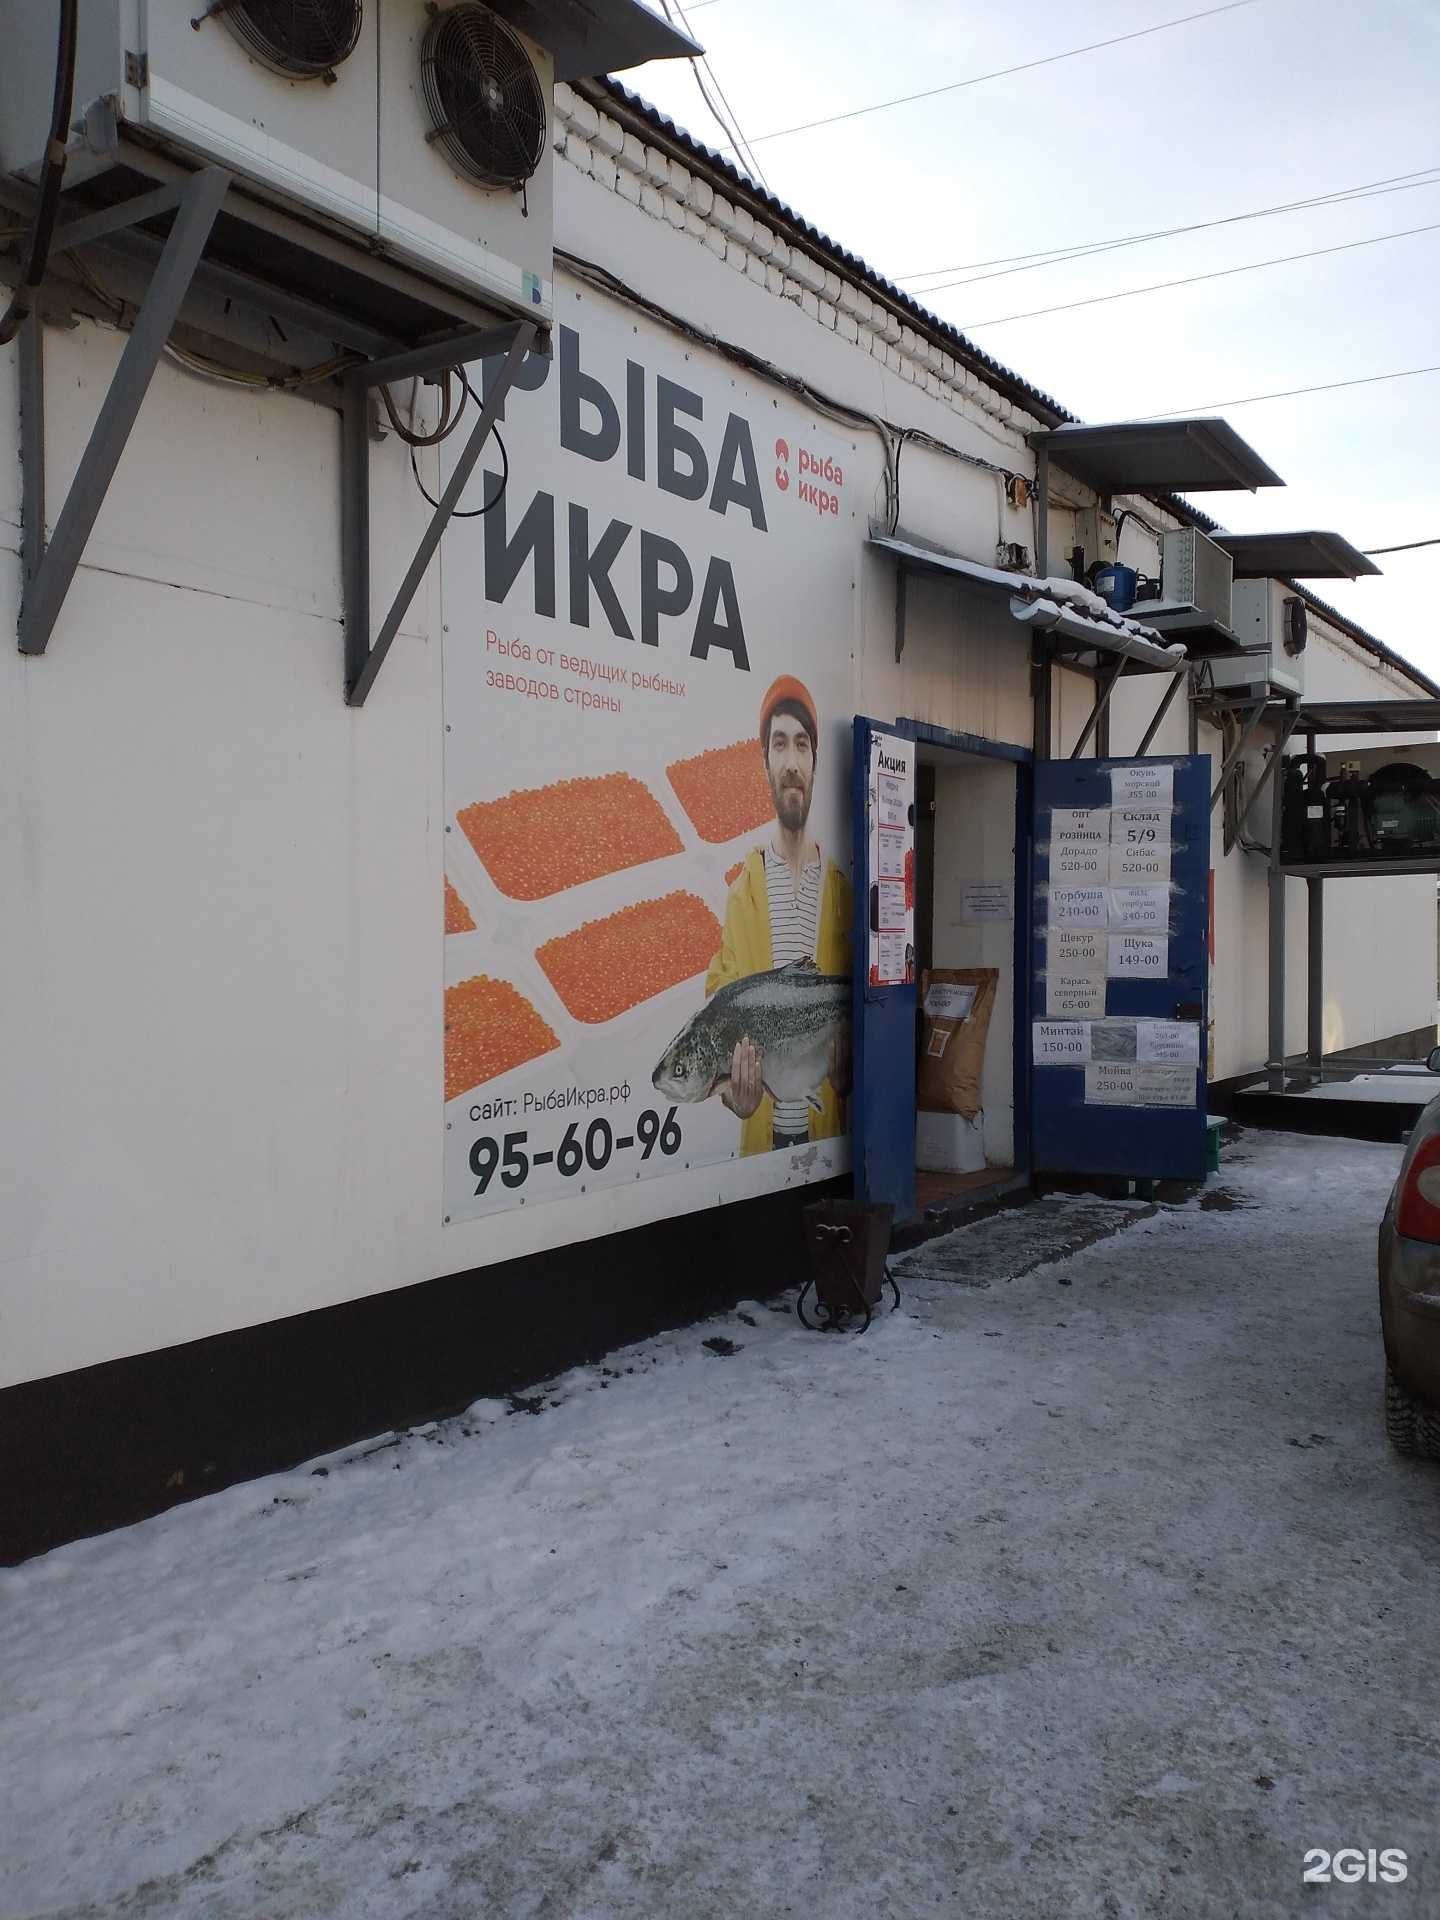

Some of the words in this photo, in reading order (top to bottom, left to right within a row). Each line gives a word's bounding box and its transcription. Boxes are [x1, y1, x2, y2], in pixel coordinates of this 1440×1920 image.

[798, 446, 843, 488] рыба
[798, 480, 839, 516] икра
[483, 469, 751, 672] ИКРА
[486, 628, 531, 663] Рыба
[536, 648, 555, 667] от
[560, 653, 628, 685] ведущих
[632, 669, 686, 698] рыбных
[486, 669, 560, 701] заводов
[563, 688, 621, 713] страны
[877, 749, 906, 775] Акция
[1123, 812, 1161, 823] Склад
[1058, 832, 1102, 840] РОЗНИЦА
[1126, 828, 1156, 845] 5/9
[1060, 846, 1098, 857] Дорадо
[1126, 847, 1156, 857] Сибас
[1061, 861, 1097, 871] 520-00
[1122, 863, 1159, 873] 520-00
[1054, 890, 1104, 901] Горбуша
[1058, 907, 1099, 917] 240-00
[1060, 933, 1094, 945] Щекур
[1123, 938, 1153, 950] Щука
[1058, 948, 1095, 958] 250-00
[1119, 955, 1159, 965] 149-00
[1060, 977, 1091, 987] Карась
[1054, 989, 1097, 998] северный
[1062, 1001, 1090, 1010] 65-00
[1040, 1025, 1084, 1036] Минтай
[1042, 1042, 1083, 1052] 150-00
[1096, 1081, 1133, 1091] 250-00
[469, 1097, 518, 1122] сайт:
[523, 1080, 632, 1115] РыбаИкра.рф
[469, 1106, 682, 1196] 95-60-96
